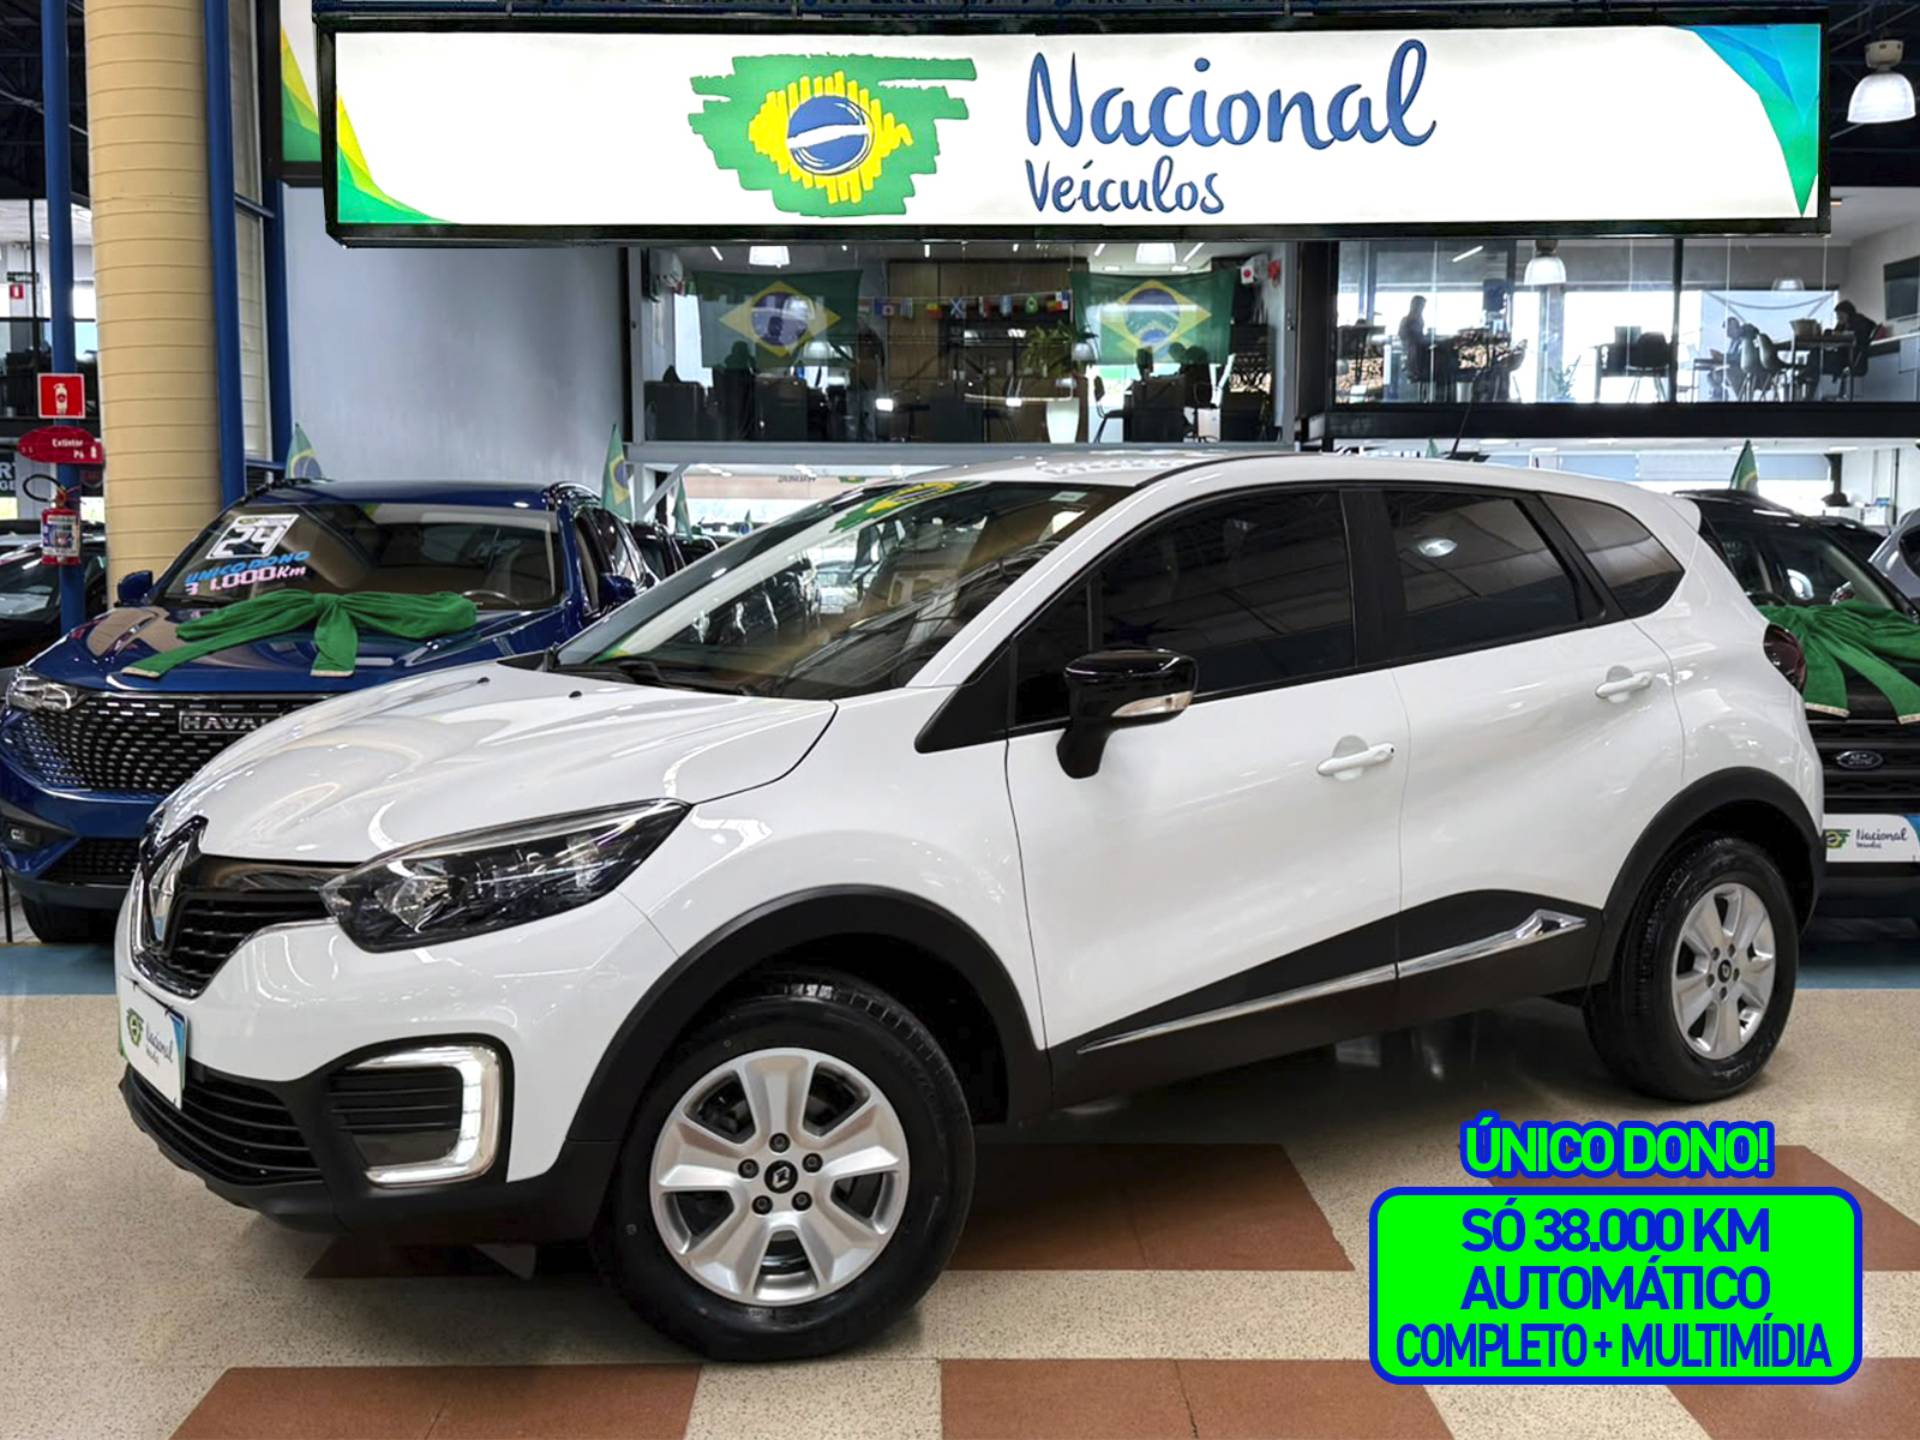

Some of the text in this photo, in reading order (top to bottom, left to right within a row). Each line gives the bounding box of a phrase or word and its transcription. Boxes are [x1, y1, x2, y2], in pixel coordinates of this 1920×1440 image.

[1026, 39, 1437, 150] Nacional
[1025, 155, 1224, 215] Veículos
[212, 526, 284, 556] 24
[183, 716, 267, 730] HAVA
